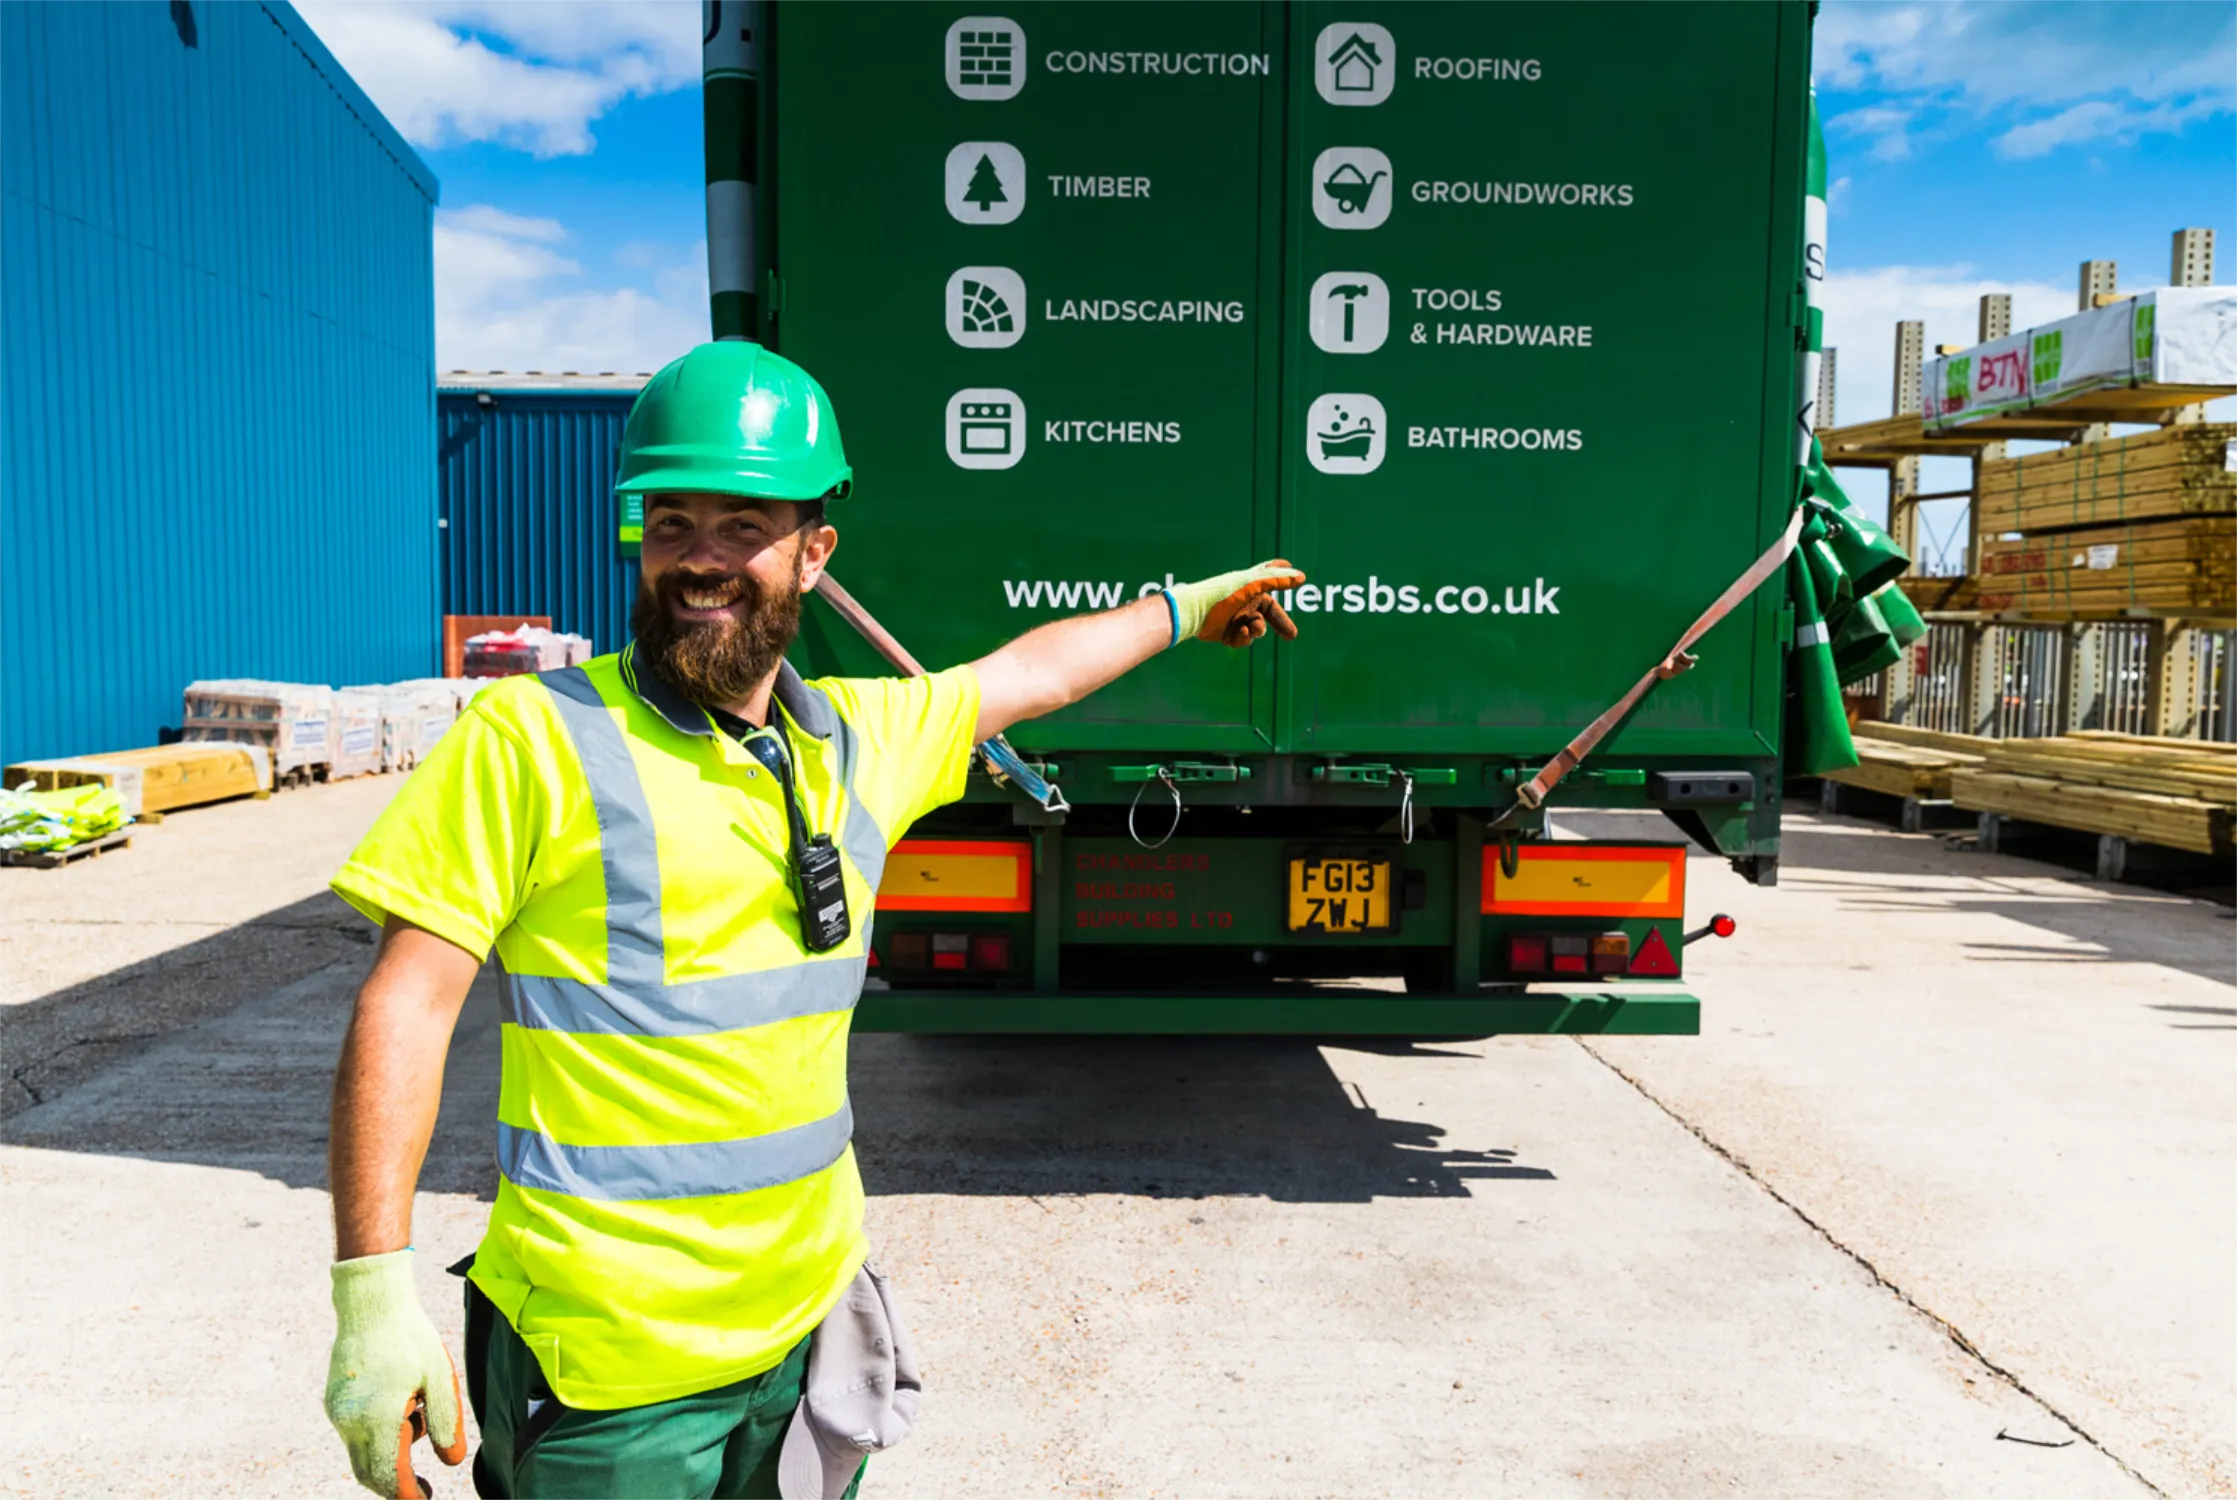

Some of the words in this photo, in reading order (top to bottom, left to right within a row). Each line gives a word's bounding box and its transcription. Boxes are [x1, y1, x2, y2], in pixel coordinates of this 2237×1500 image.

[1045, 51, 1270, 77] CONSTRUCTION
[1414, 57, 1542, 82] ROOFING
[1047, 175, 1152, 199] TIMBER
[1411, 180, 1635, 207] GROUNDWORKS
[1045, 299, 1245, 324] LANDSCAPING
[1411, 288, 1503, 313] TOOLS
[1410, 322, 1428, 345] &
[1436, 323, 1593, 347] HARDWARE
[1045, 420, 1181, 444] KITCHENS
[1407, 426, 1584, 451] BATHROOMS
[1003, 573, 1561, 615] wwwclersbs.co.uk
[1076, 854, 1210, 871] CHANDLERS
[1302, 862, 1375, 893] FG13
[1075, 882, 1175, 900] BUILDING
[1076, 910, 1179, 929] SUPPLIES
[1191, 911, 1233, 929] LTD
[1305, 897, 1371, 928] ZWJ
